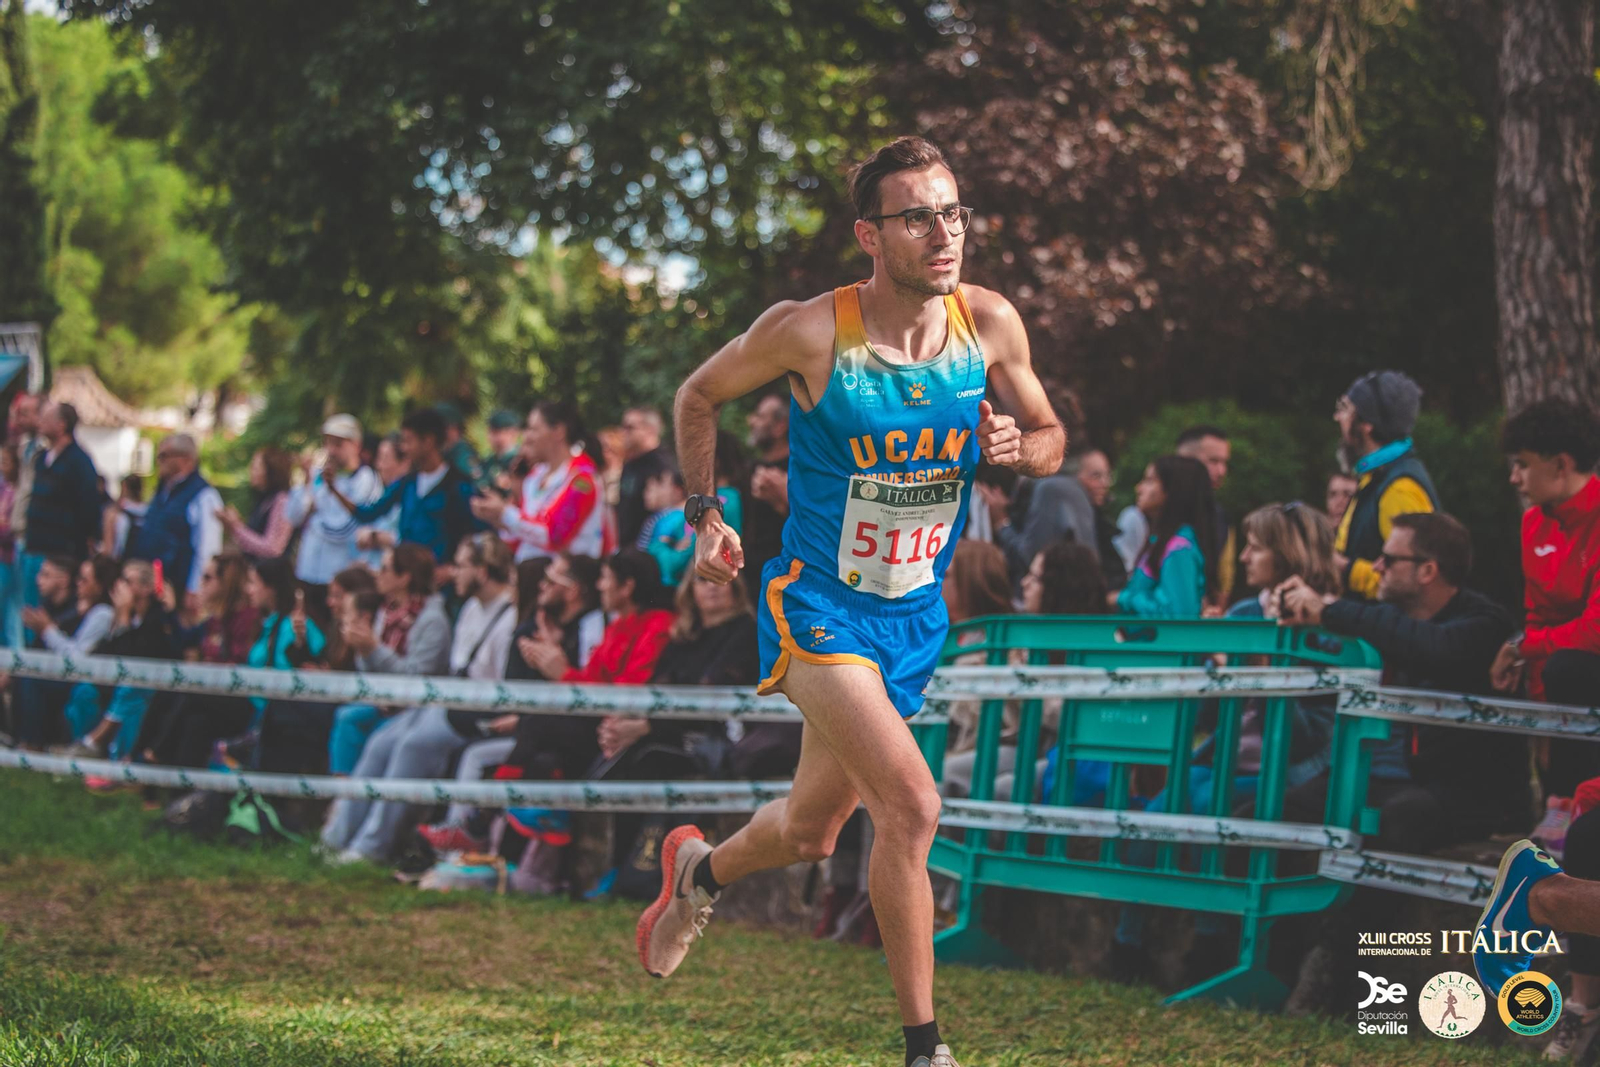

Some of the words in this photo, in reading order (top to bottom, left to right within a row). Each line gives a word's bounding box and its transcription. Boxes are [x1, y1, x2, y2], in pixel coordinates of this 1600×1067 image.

[859, 379, 881, 387] Costa
[848, 428, 972, 469] UCAM
[854, 466, 960, 485] IVERSIDAD
[886, 488, 937, 504] ITÁLICA
[851, 521, 944, 566] 5116
[810, 634, 836, 648] KELME
